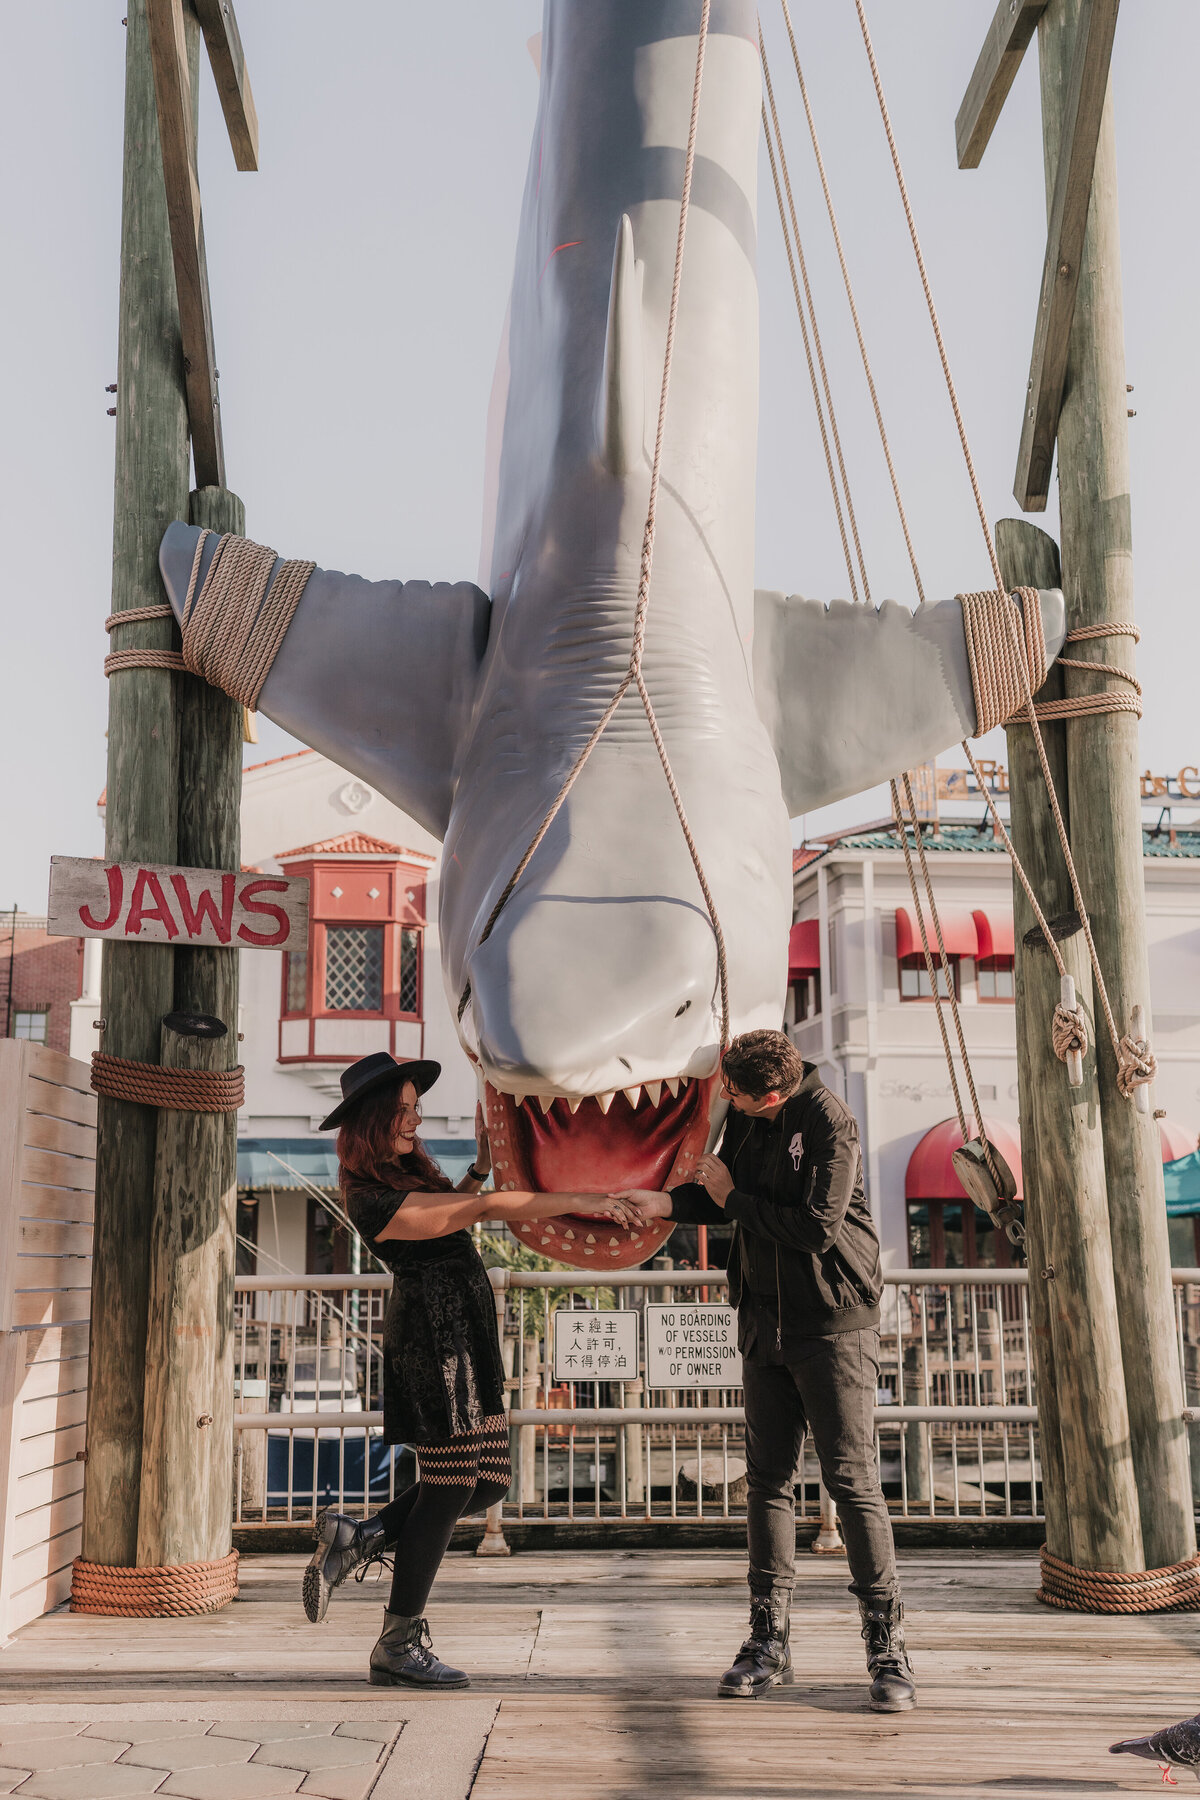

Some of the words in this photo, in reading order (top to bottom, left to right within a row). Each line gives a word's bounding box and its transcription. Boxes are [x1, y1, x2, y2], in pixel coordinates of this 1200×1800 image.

[79, 864, 291, 946] JAWS
[661, 1314, 675, 1326] NO
[680, 1313, 731, 1326] BOARDING
[572, 1320, 618, 1334] 未經主
[665, 1330, 678, 1343] OF
[683, 1330, 728, 1343] VESSELS
[675, 1346, 736, 1359] PERMISSION
[564, 1354, 627, 1368] 不得停泊
[669, 1363, 682, 1376] OF
[687, 1363, 722, 1376] OWNER
